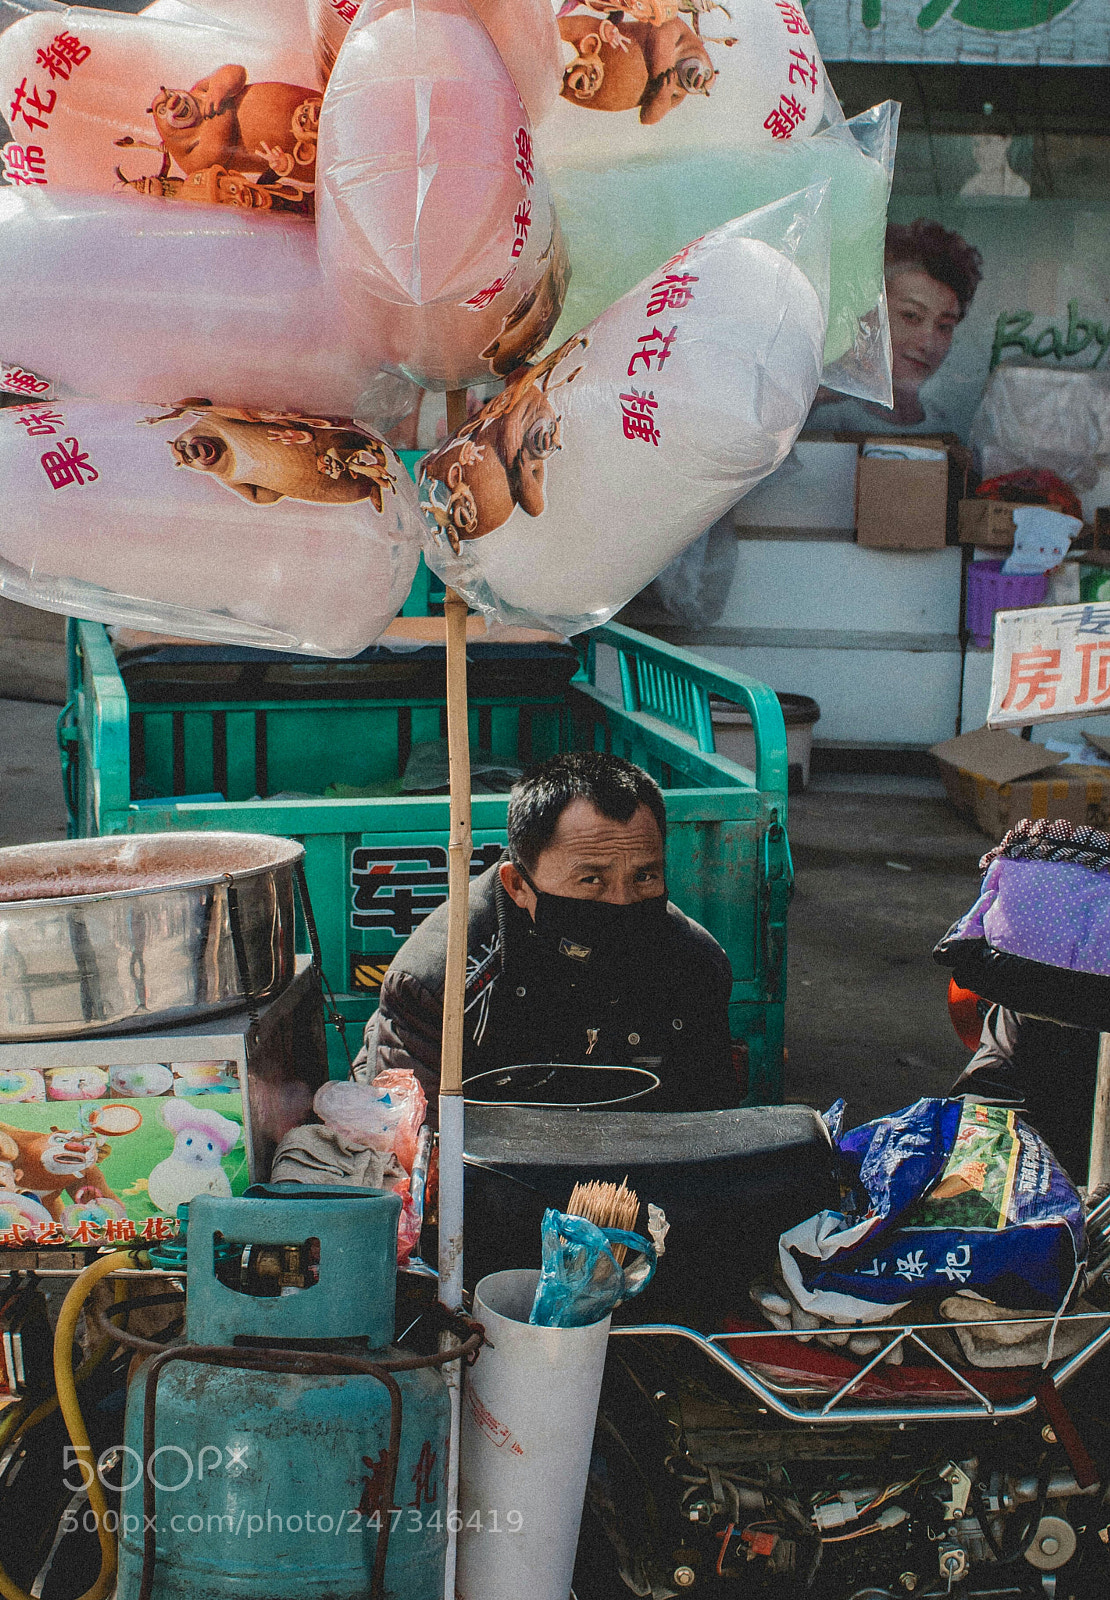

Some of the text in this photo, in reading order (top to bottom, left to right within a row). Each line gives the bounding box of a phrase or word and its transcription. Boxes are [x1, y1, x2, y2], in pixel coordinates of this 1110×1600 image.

[4, 30, 92, 186] 棉花糖
[12, 405, 99, 490] 果味
[0, 1217, 182, 1245] 式艺术棉花
